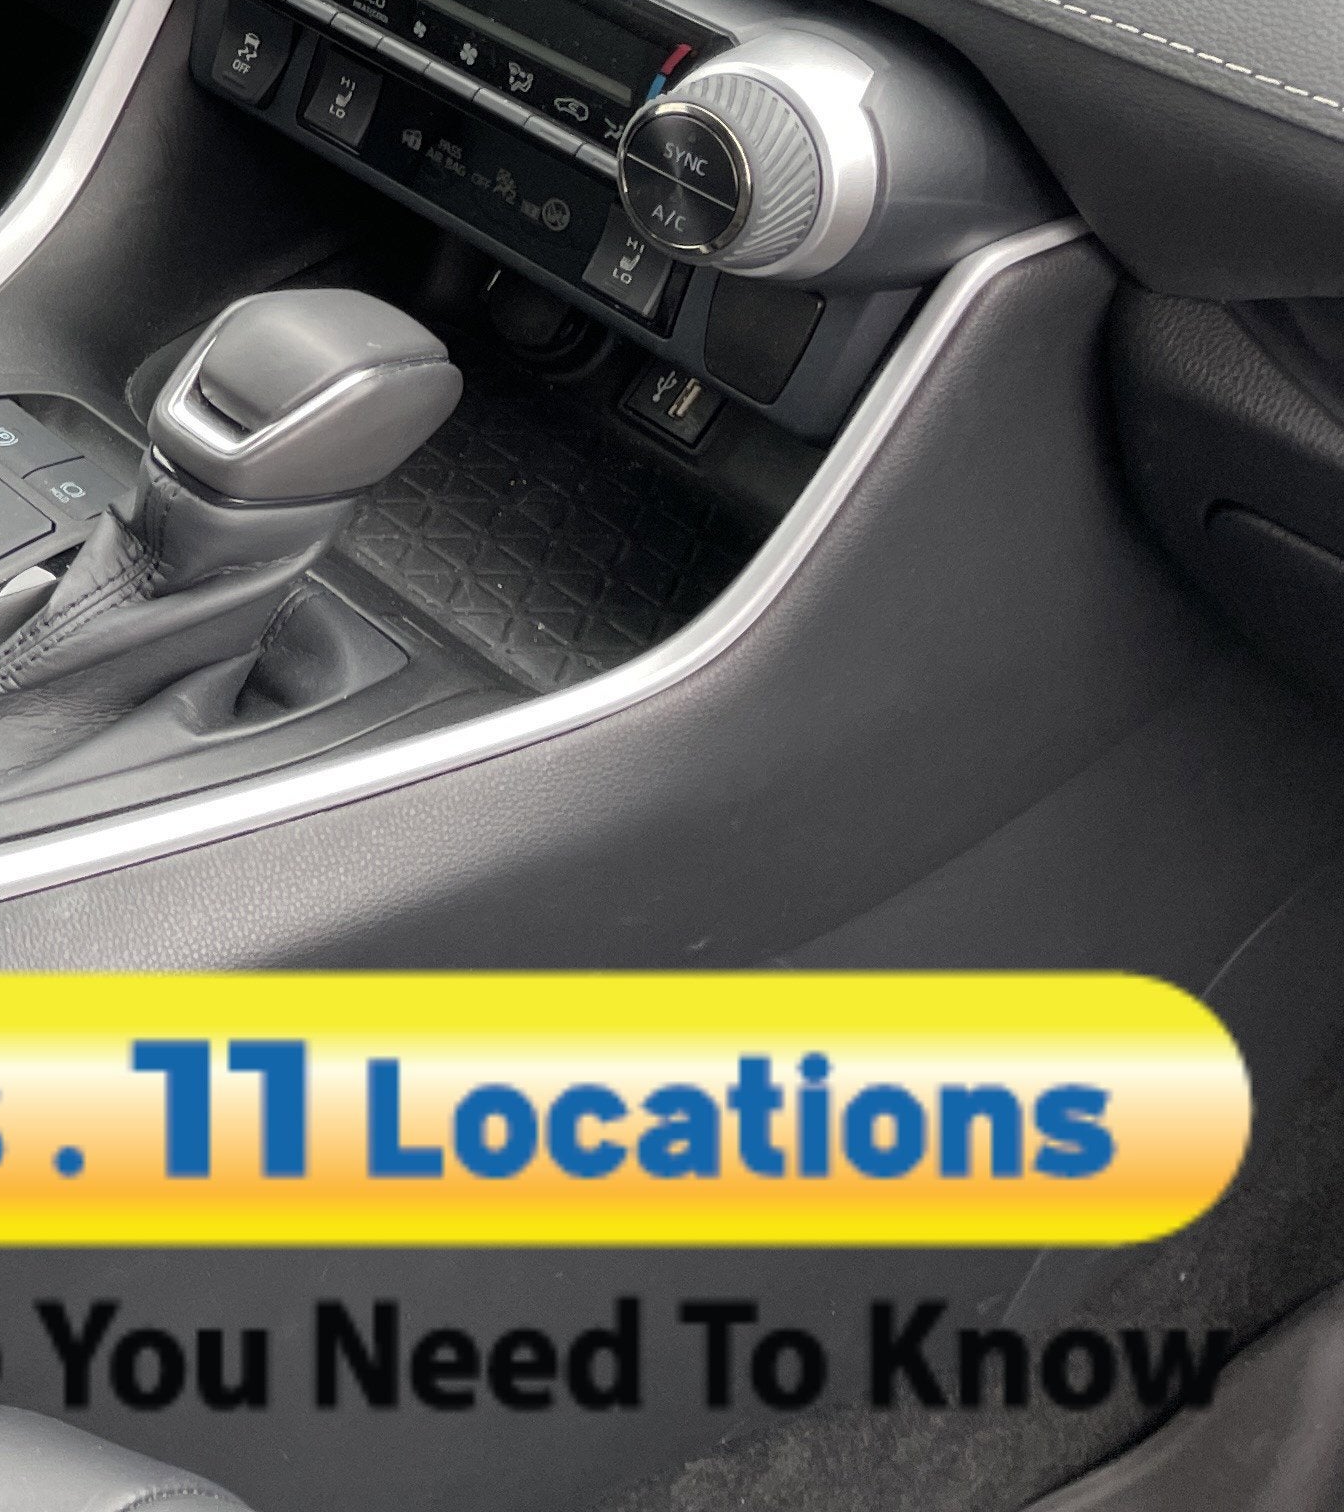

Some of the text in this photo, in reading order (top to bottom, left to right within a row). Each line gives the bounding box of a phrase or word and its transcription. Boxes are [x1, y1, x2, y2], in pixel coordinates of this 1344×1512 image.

[232, 59, 251, 74] OFF
[340, 75, 356, 91] HI
[328, 104, 346, 119] LO
[662, 142, 709, 177] SYNC
[651, 204, 686, 232] A/C
[613, 268, 632, 284] LO
